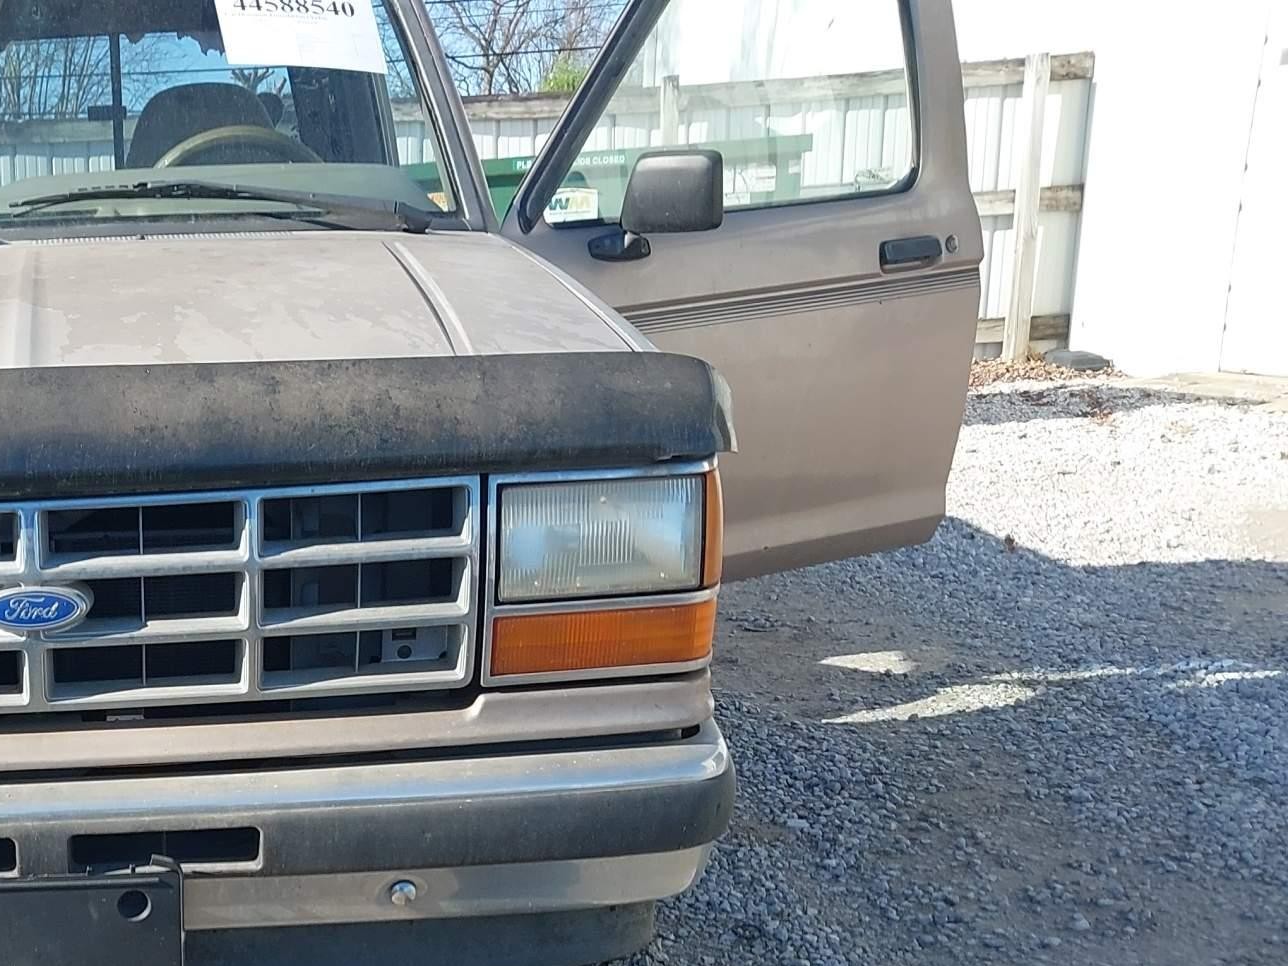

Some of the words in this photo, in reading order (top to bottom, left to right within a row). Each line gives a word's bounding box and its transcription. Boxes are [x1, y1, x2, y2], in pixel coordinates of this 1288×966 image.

[233, 0, 355, 17] 44588540
[592, 154, 625, 165] CLOSED
[5, 596, 60, 620] Ford
